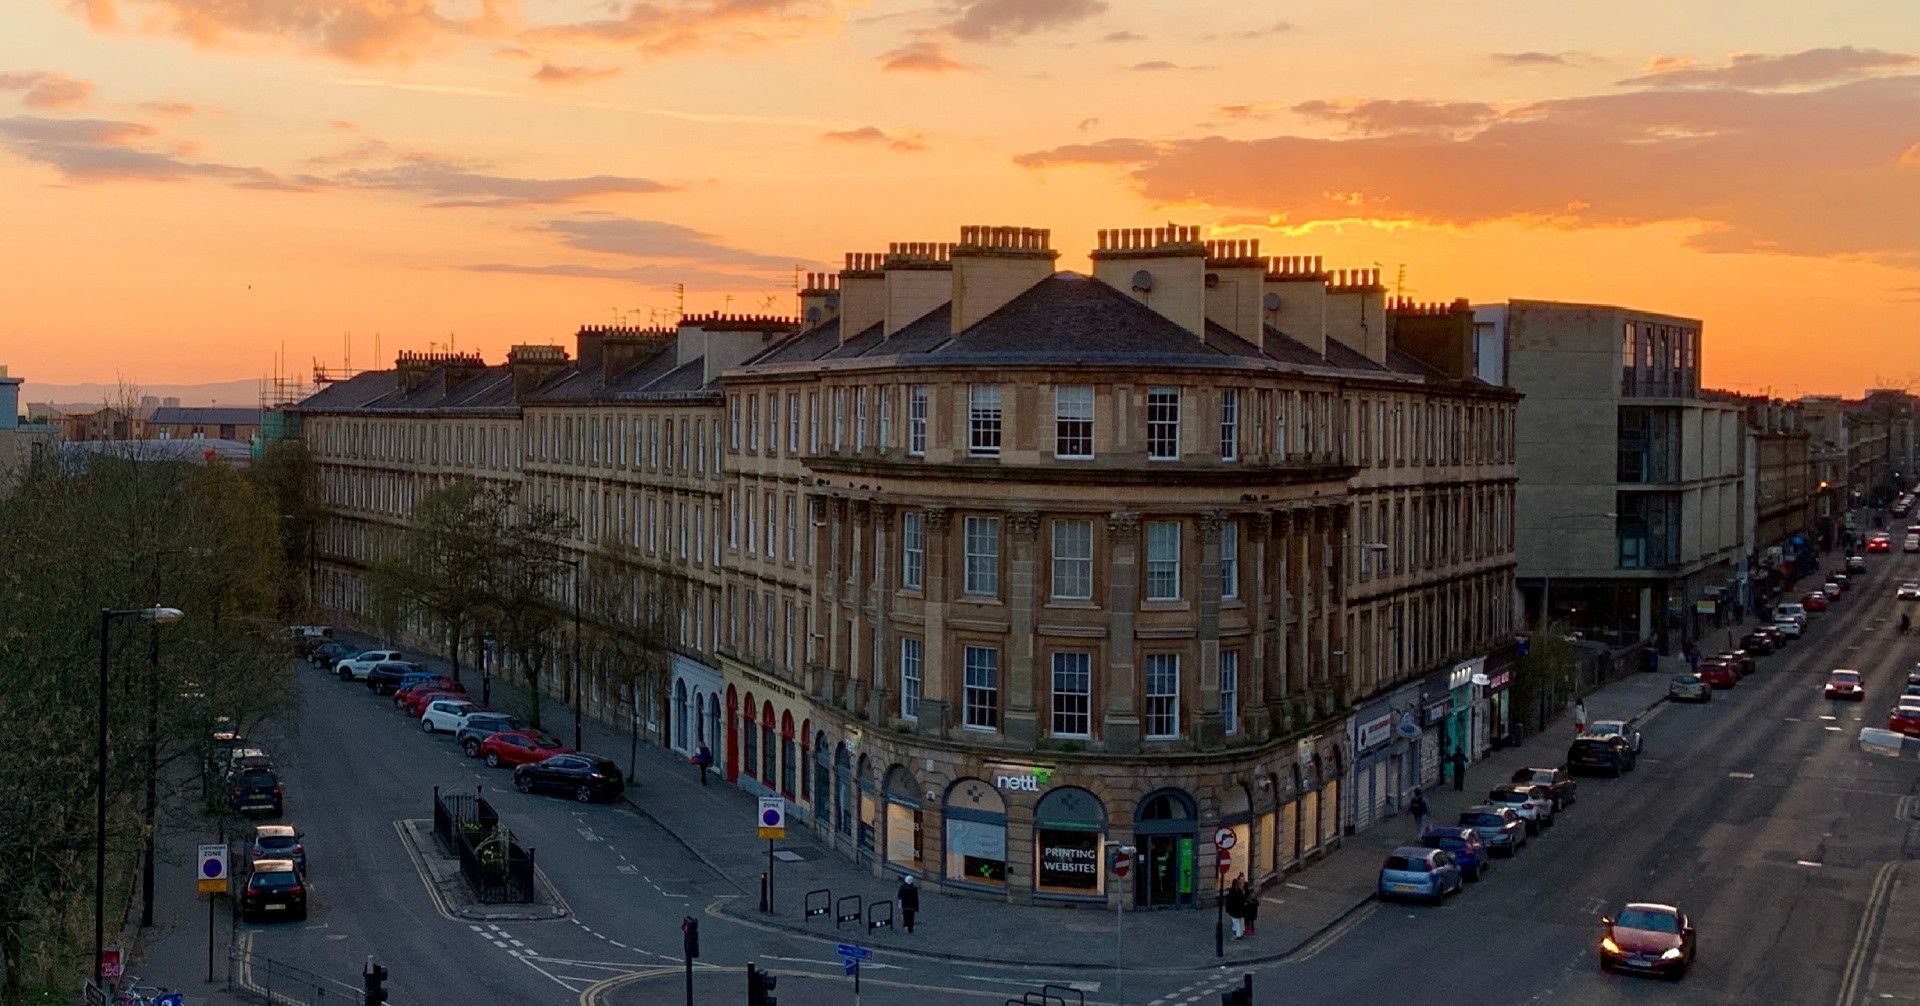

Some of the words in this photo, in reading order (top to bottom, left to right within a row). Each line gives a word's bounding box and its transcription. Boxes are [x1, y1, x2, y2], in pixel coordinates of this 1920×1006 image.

[997, 775, 1039, 791] nettl
[1045, 847, 1096, 860] PRINTING
[1044, 861, 1096, 874] WEBSITES
